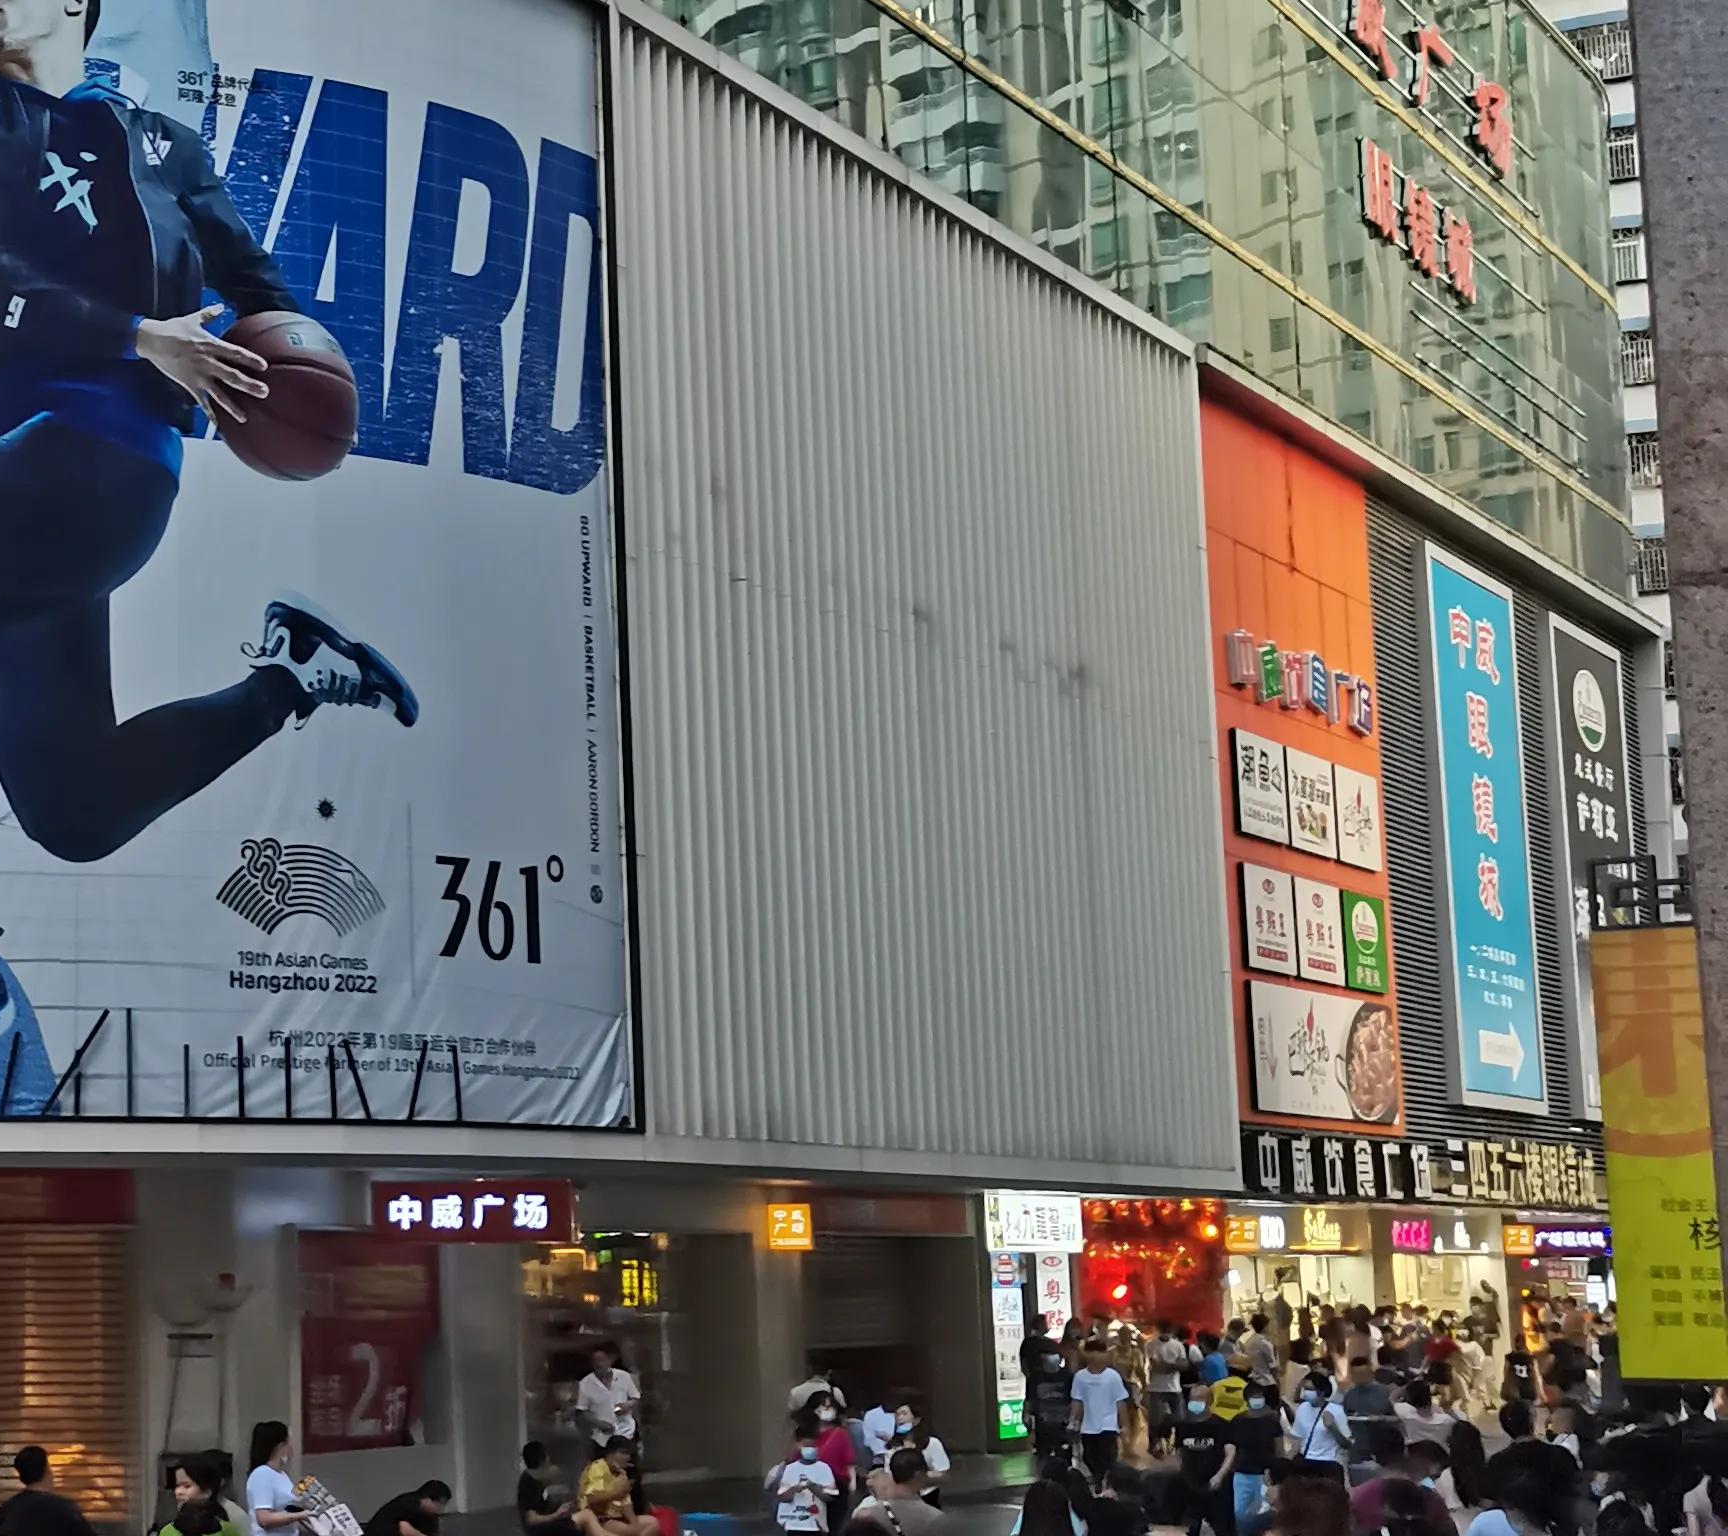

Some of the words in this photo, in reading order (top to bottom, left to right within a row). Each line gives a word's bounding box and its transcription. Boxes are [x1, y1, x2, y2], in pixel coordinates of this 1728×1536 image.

[582, 625, 598, 721] BASKETBALL
[434, 853, 565, 965] 361°
[237, 950, 272, 968] 19th
[275, 951, 317, 969] Asian
[320, 954, 368, 971] Games
[229, 970, 330, 995] Hangzhou
[334, 974, 378, 994] 2022
[203, 1052, 256, 1068] Offical
[261, 1054, 321, 1073] Pretige
[324, 1055, 376, 1072] arner
[425, 1059, 457, 1074] Asia
[386, 1192, 550, 1231] 中威广场
